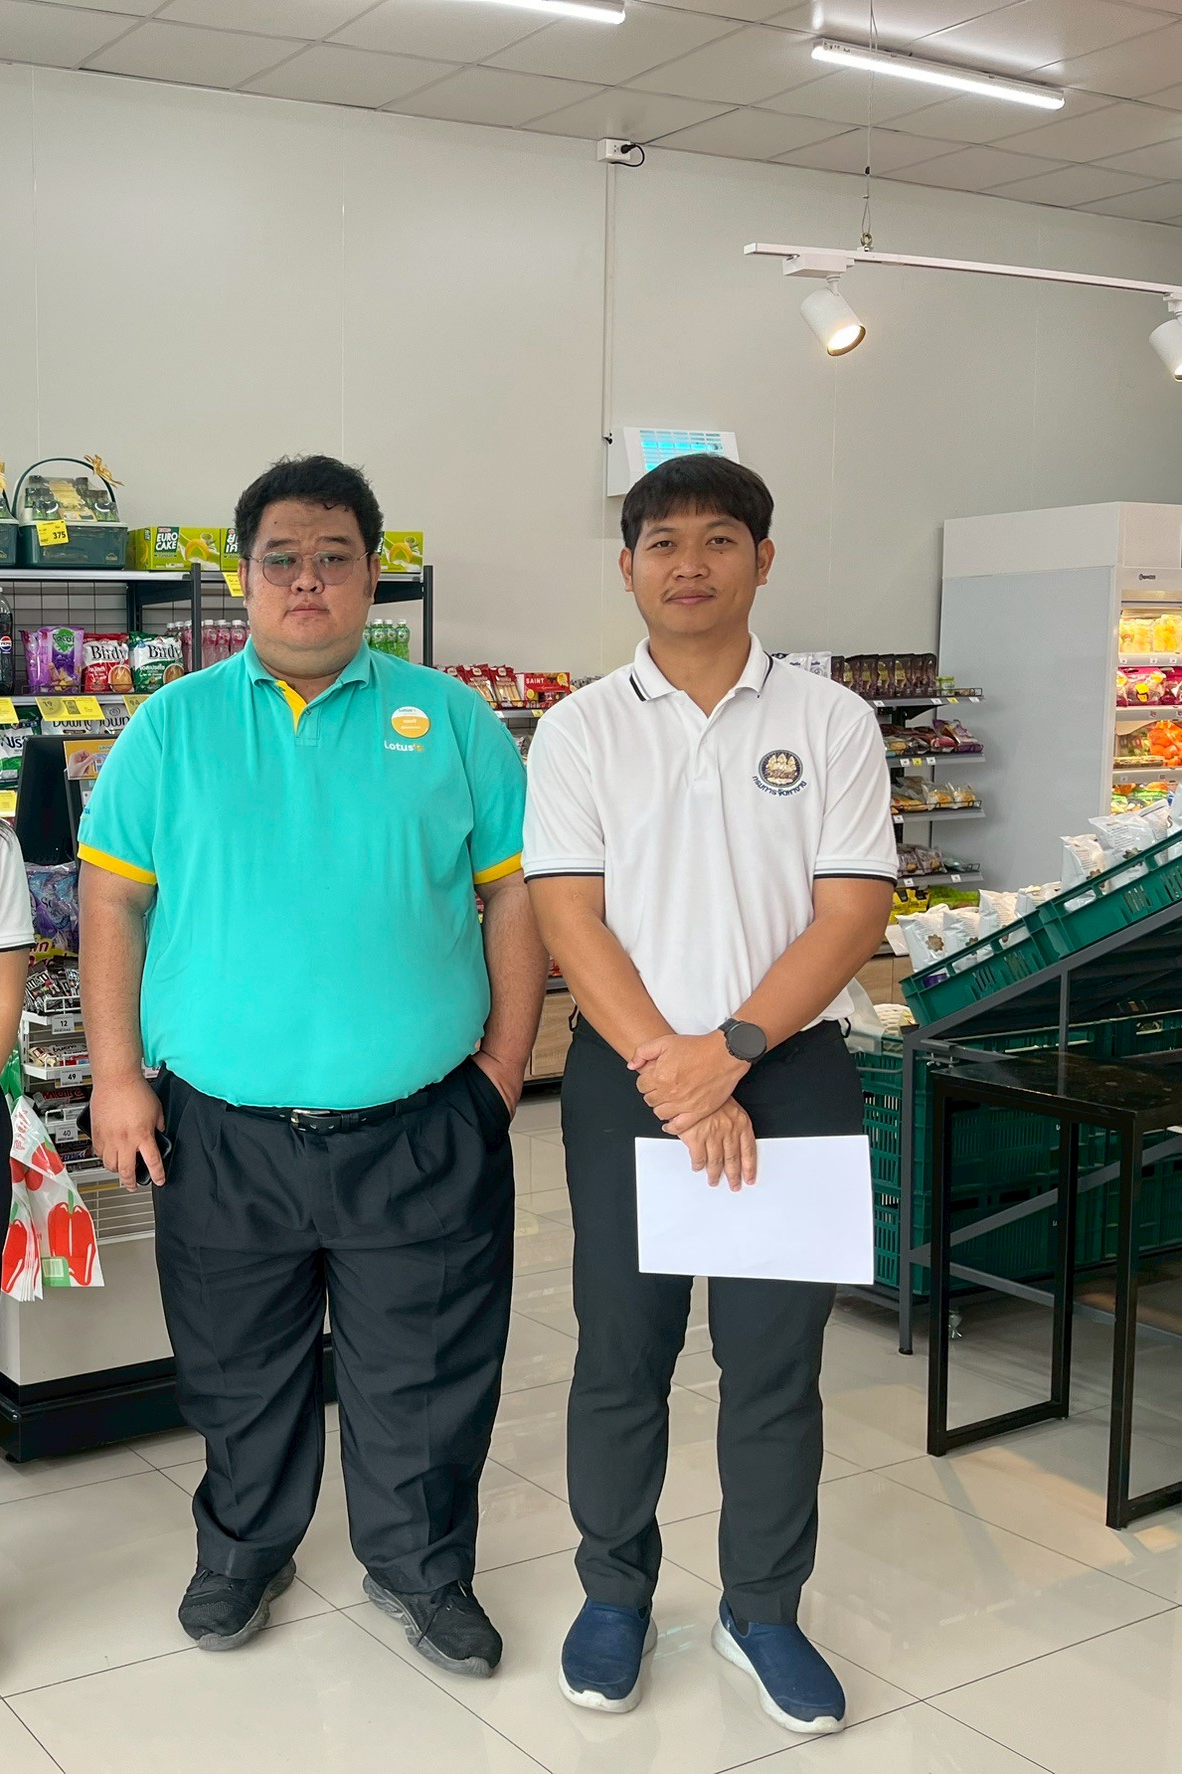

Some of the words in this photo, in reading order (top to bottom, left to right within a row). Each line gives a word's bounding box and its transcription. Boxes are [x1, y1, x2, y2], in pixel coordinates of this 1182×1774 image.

[52, 532, 66, 540] 375
[157, 532, 178, 541] EURO
[156, 541, 177, 550] CAKE
[91, 646, 127, 664] Birdy
[148, 645, 180, 662] Birdy
